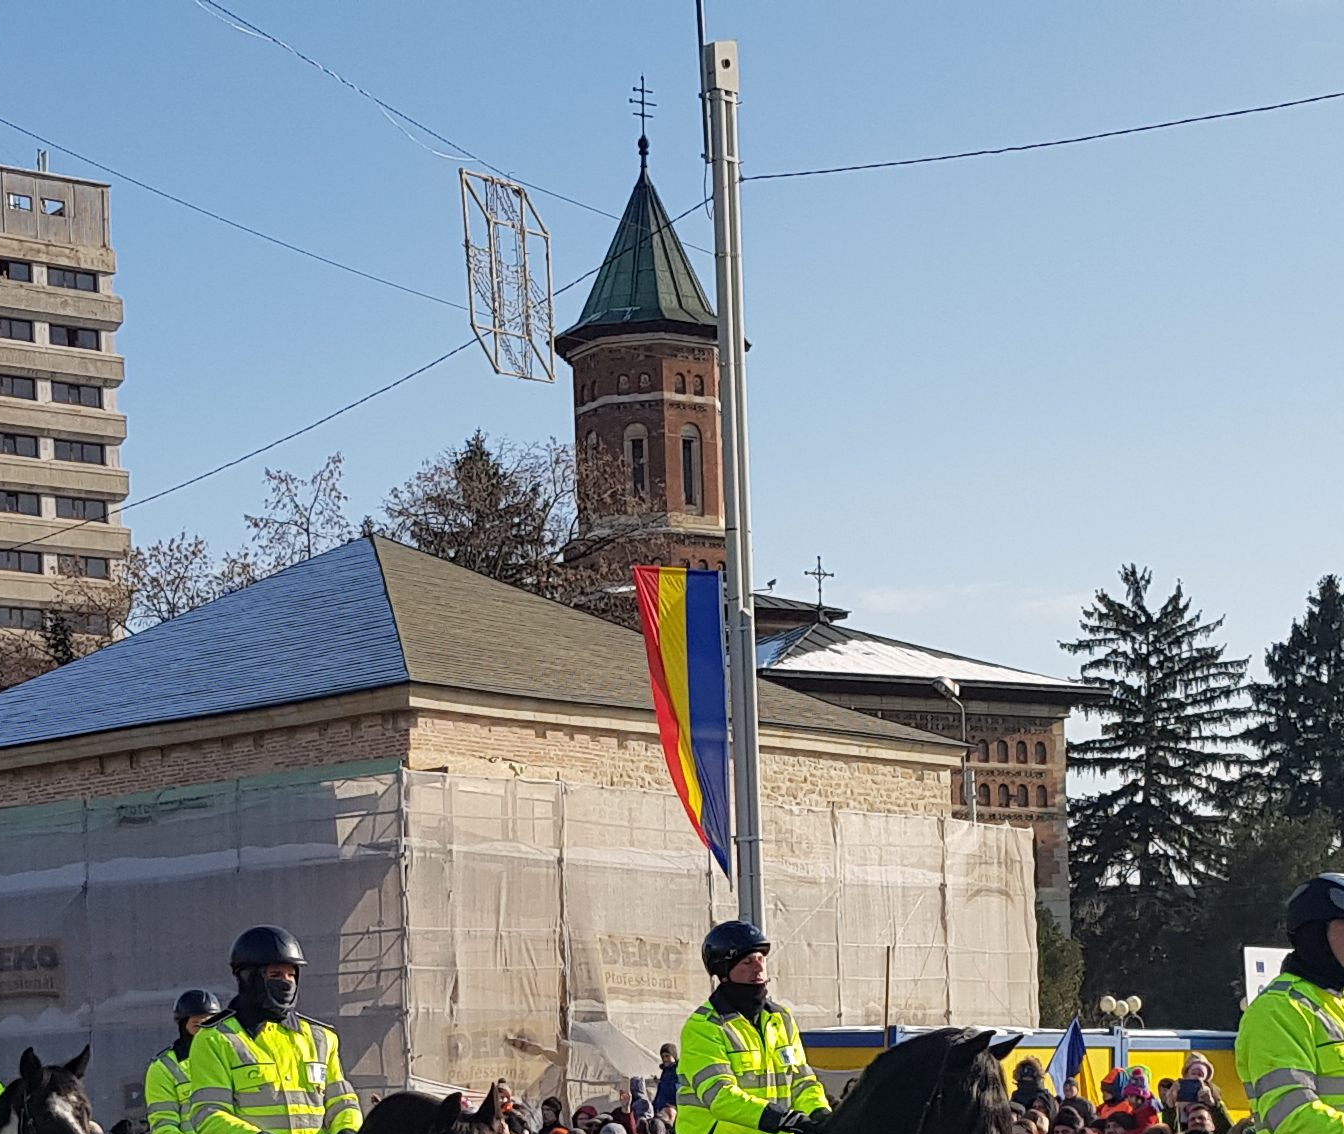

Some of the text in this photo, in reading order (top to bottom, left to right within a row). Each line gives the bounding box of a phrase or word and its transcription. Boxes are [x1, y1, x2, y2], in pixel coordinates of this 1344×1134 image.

[600, 938, 683, 970] DEKO
[605, 971, 678, 990] Professional
[448, 1065, 530, 1083] Professional
